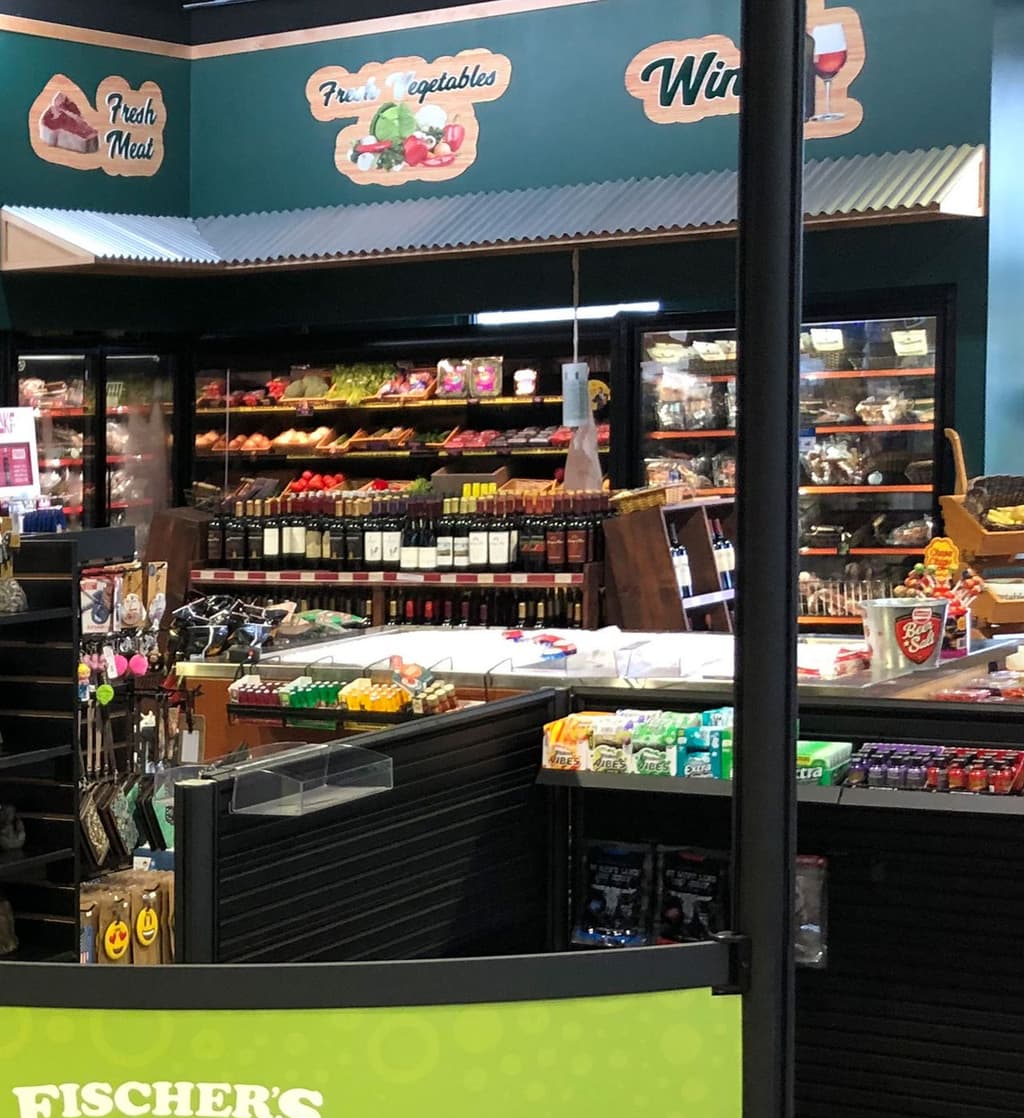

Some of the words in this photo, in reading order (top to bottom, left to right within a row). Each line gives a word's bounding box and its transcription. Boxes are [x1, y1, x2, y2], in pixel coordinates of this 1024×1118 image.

[319, 80, 381, 107] Fresh
[387, 66, 497, 104] Vegetables
[106, 92, 157, 125] Fresh
[105, 129, 155, 160] Meat
[902, 622, 934, 640] Beer
[908, 630, 935, 653] Salt
